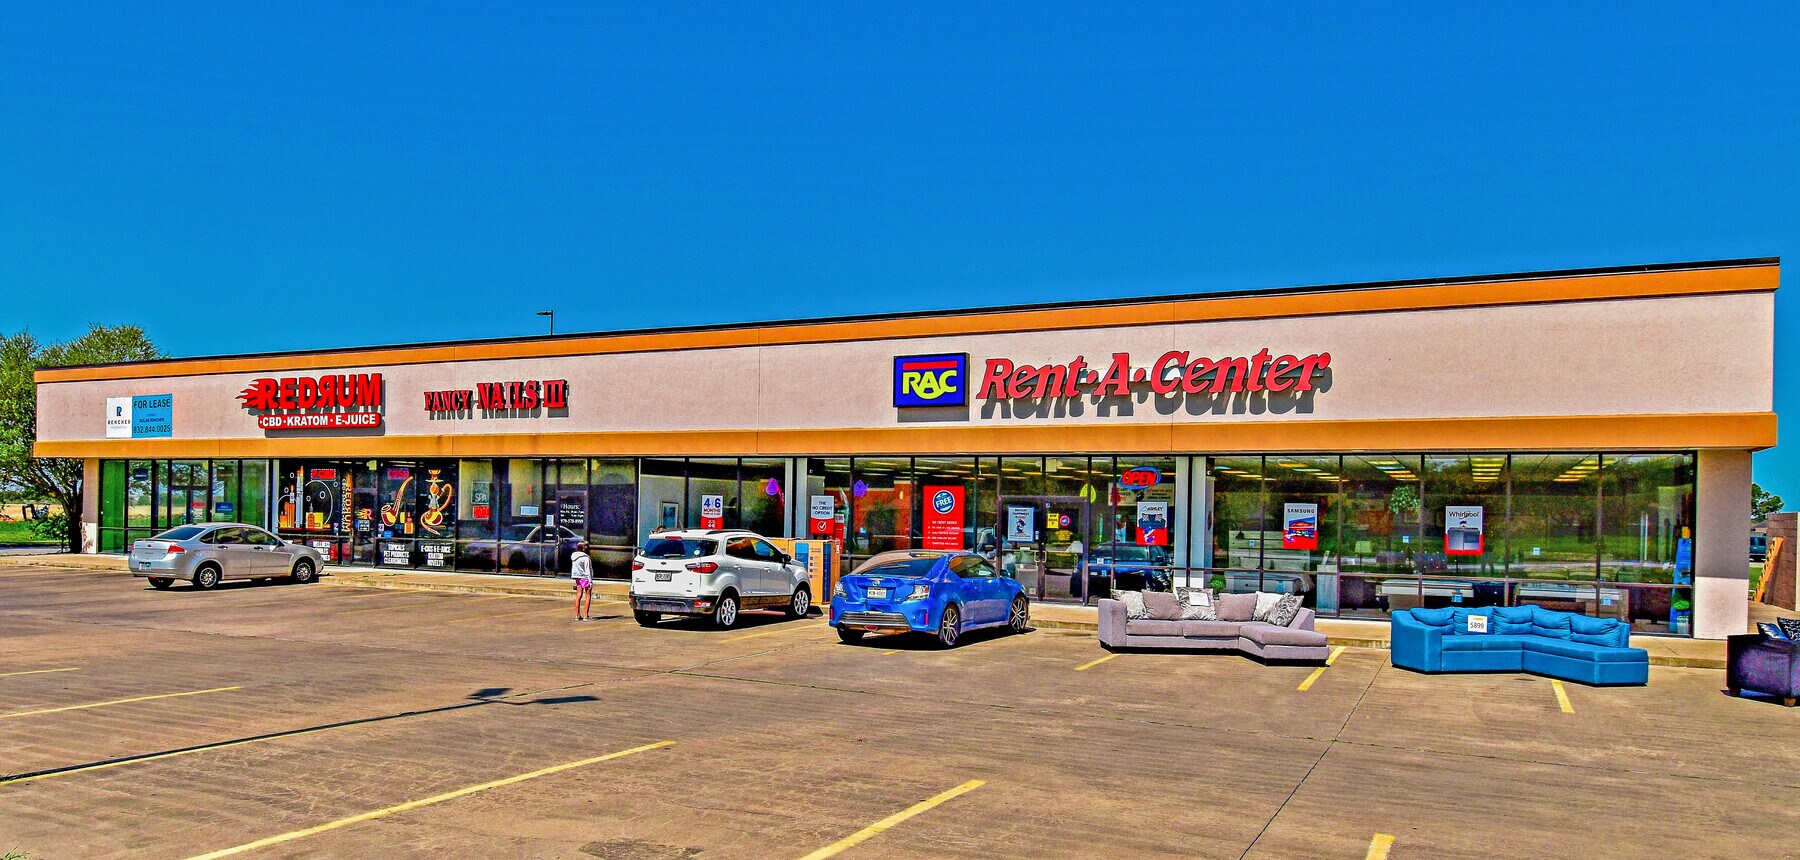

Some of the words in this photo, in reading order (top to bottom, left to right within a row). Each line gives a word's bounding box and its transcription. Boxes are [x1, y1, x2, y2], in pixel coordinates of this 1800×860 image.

[903, 370, 957, 399] RAC
[424, 390, 471, 411] FANCY
[476, 380, 539, 409] NAILS
[542, 379, 566, 408] III
[133, 400, 147, 408] FOR
[149, 399, 170, 408] LEASE
[261, 416, 282, 427] CBD
[287, 415, 328, 427] KRATOM
[335, 414, 376, 425] E-JUICE
[133, 425, 170, 434] 832.844.0025
[1121, 470, 1157, 486] OPEN
[475, 492, 487, 502] SPA
[935, 496, 952, 507] FREE
[714, 498, 721, 508] 6
[1448, 510, 1479, 519] Whirlpool
